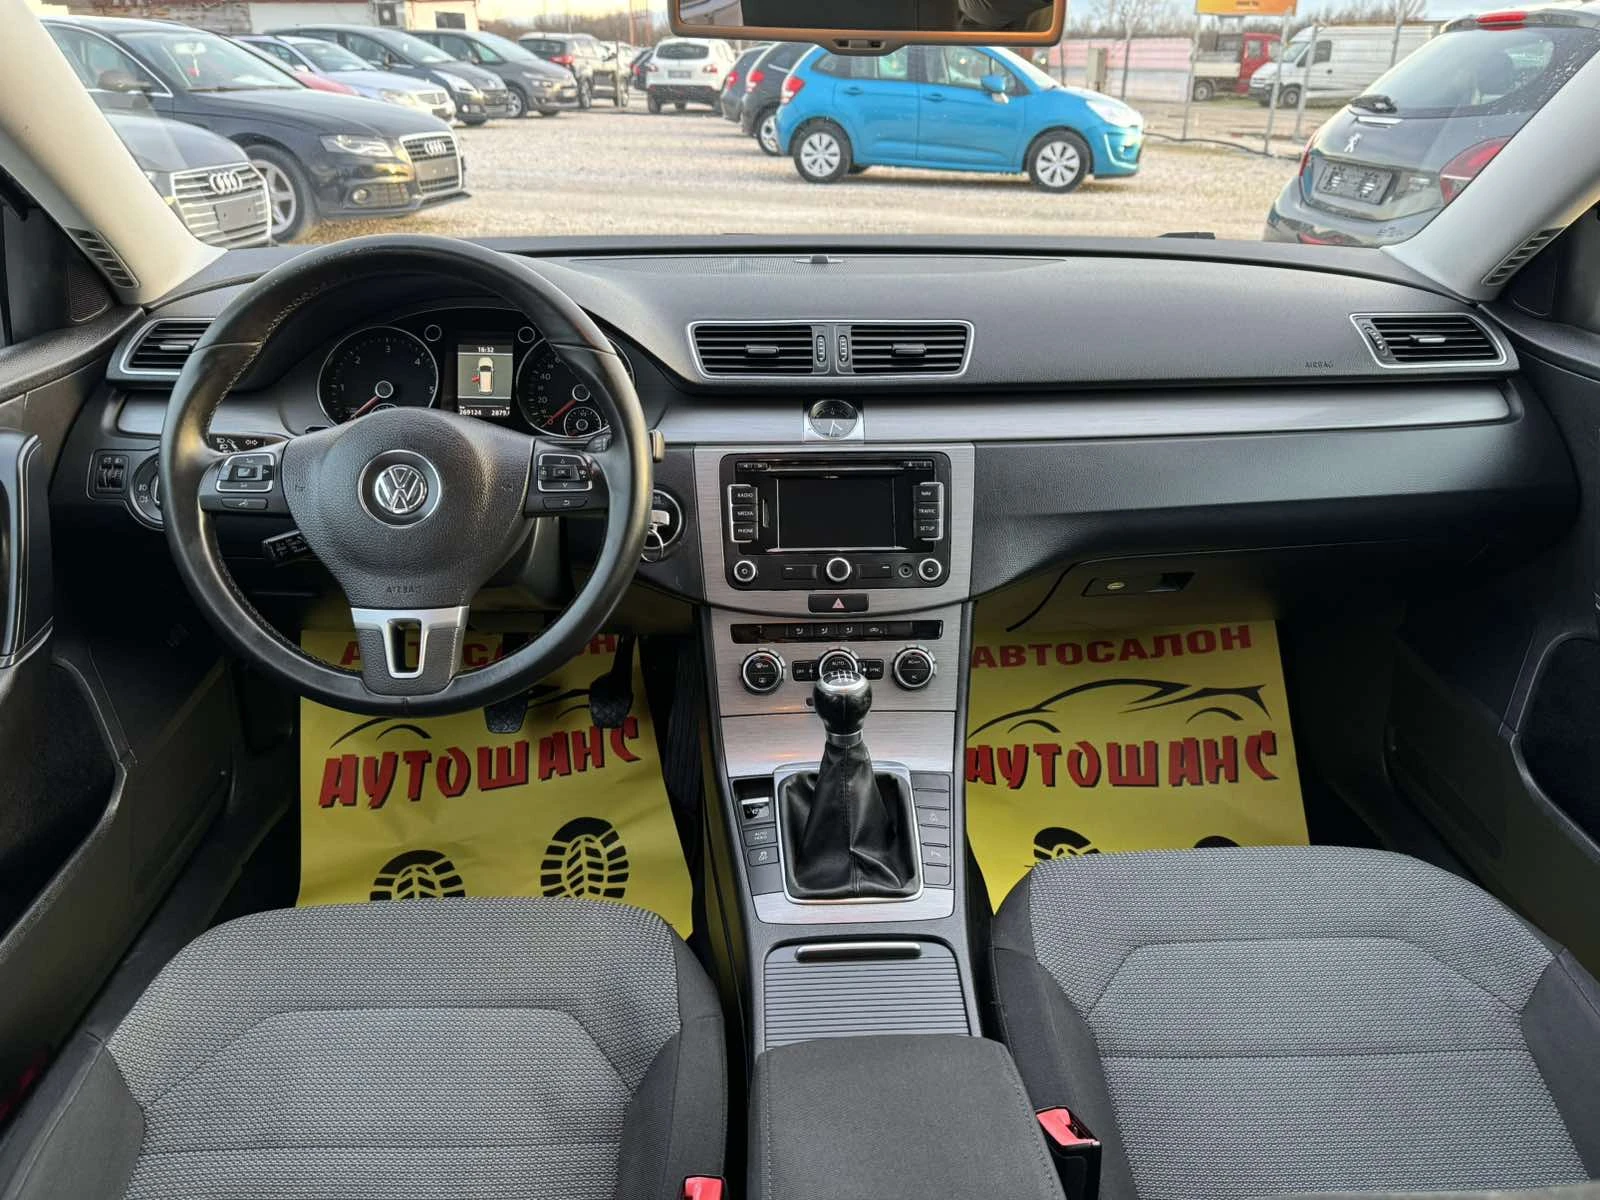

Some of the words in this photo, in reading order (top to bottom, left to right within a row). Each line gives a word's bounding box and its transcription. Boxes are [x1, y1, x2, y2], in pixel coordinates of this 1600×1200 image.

[970, 624, 1253, 669] АВТОСАЛОН
[318, 715, 642, 809] АУТОШАНС
[966, 729, 1279, 789] АУТОШАНС
